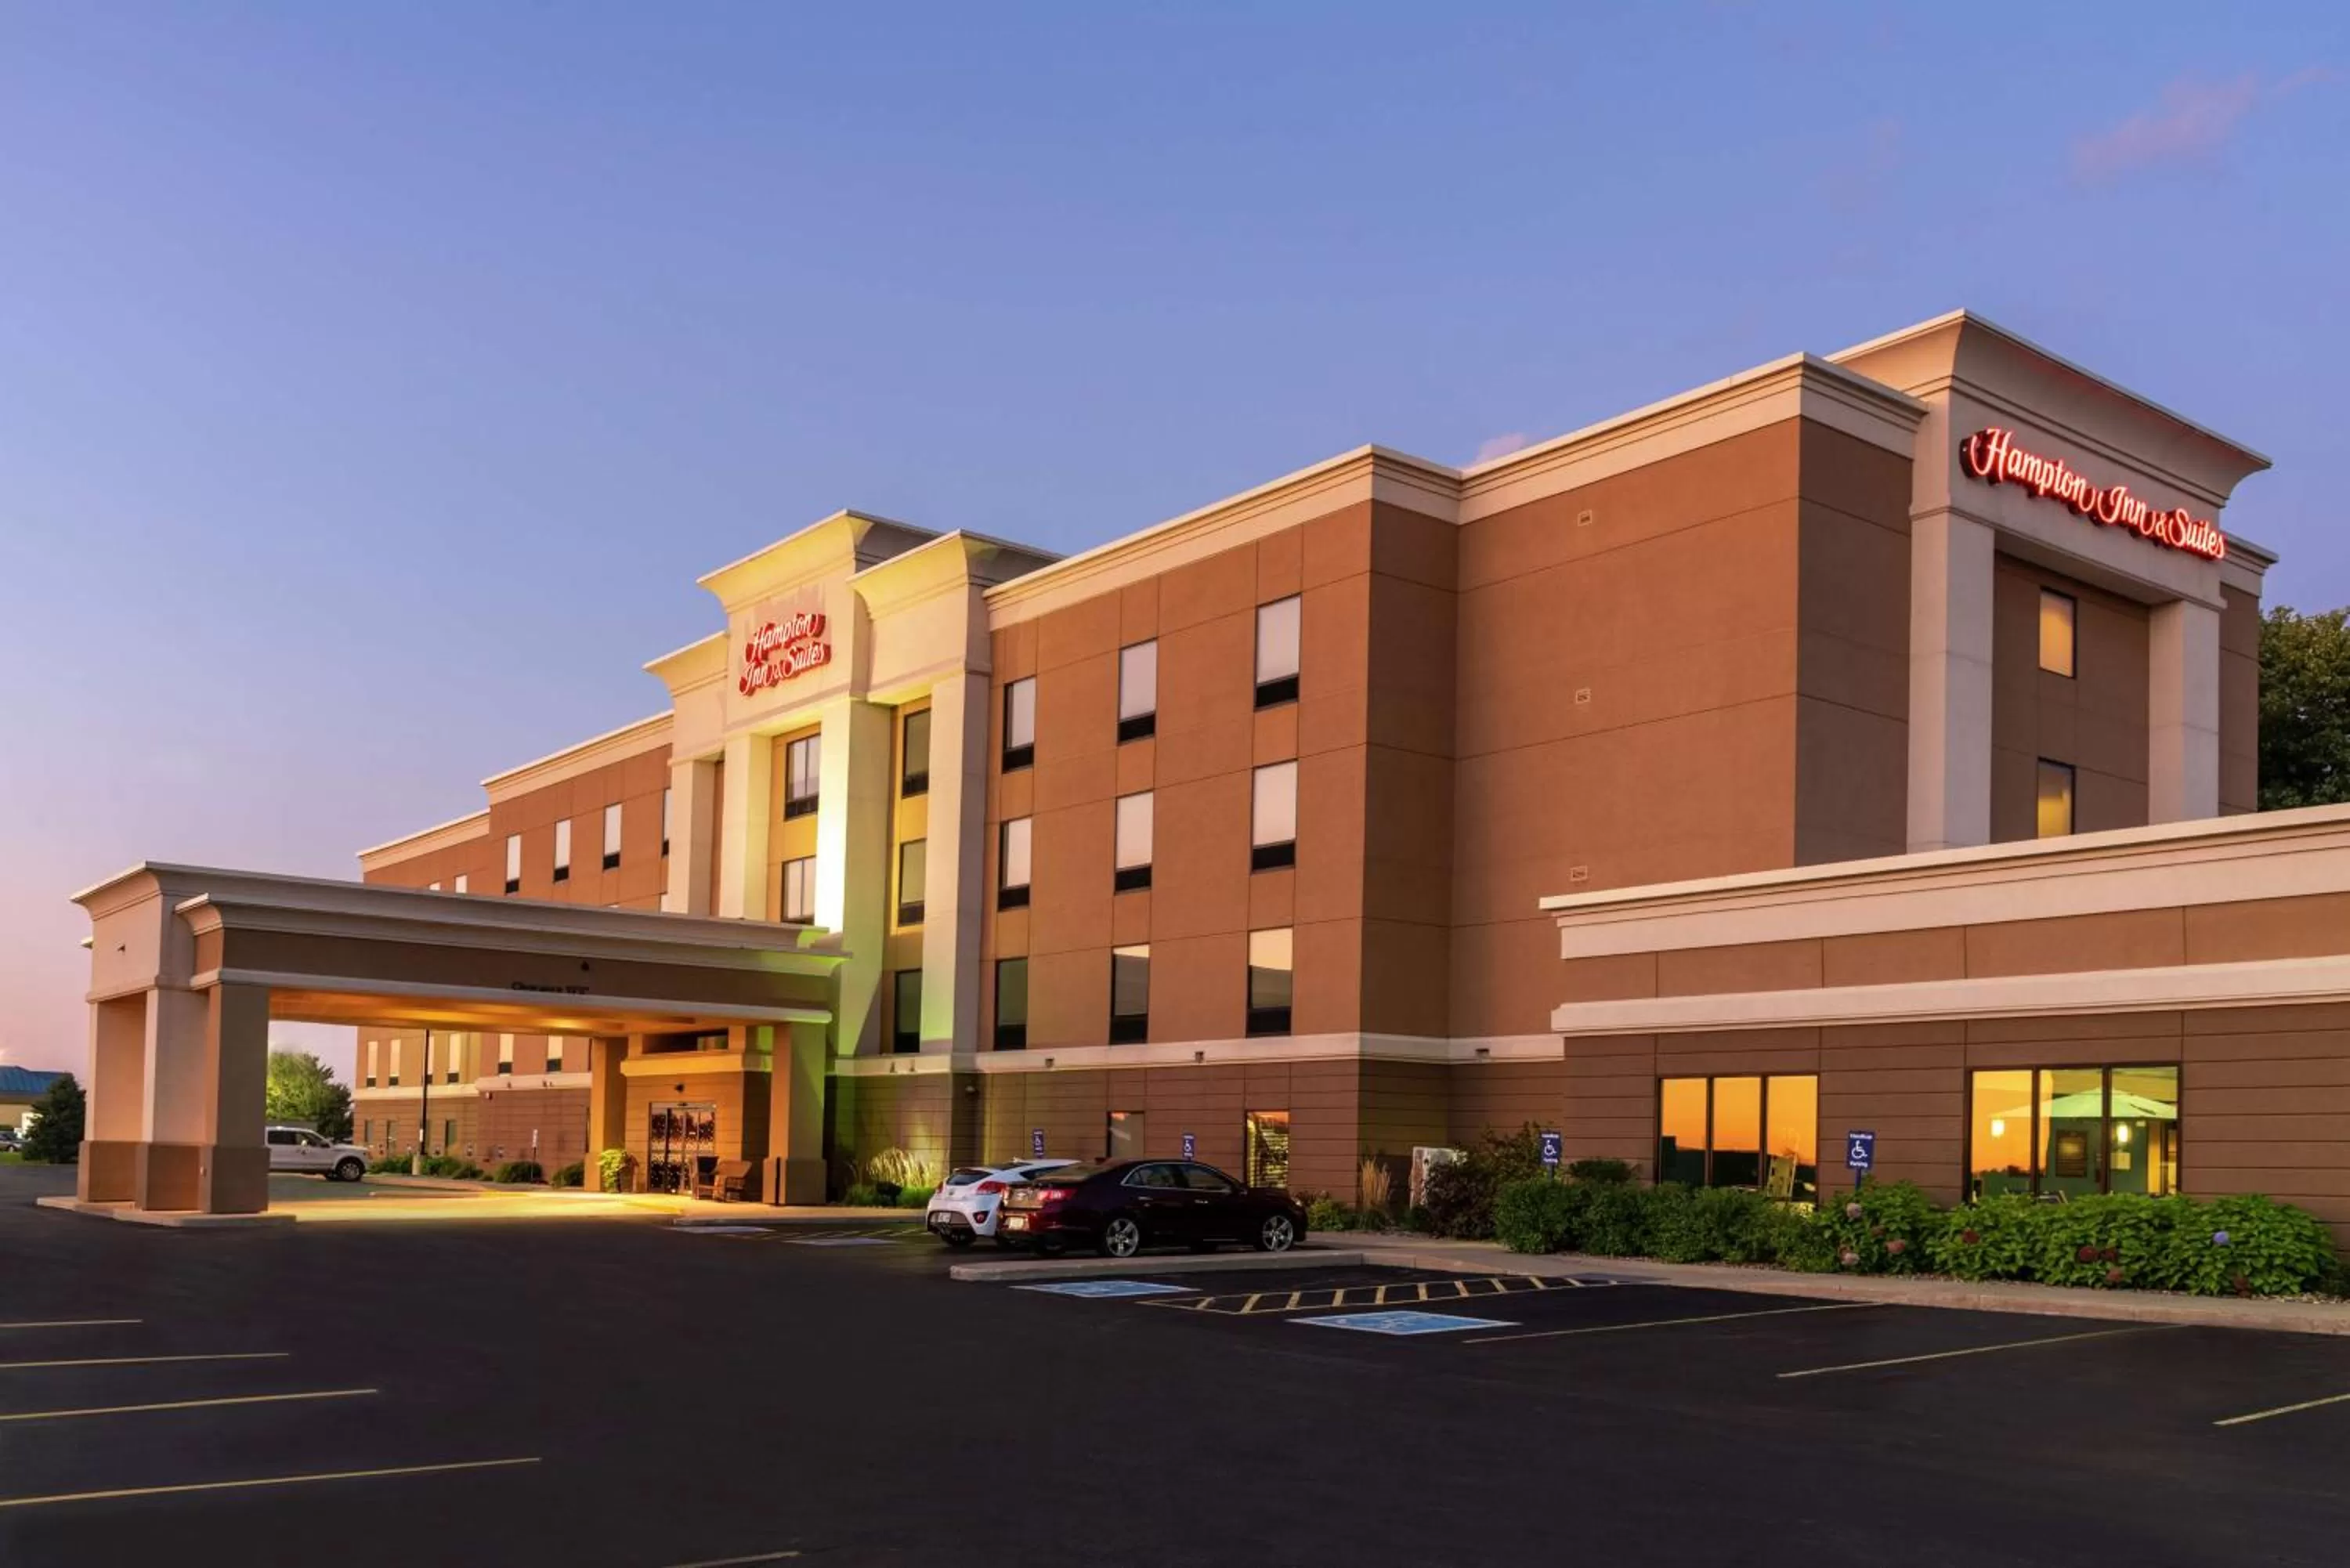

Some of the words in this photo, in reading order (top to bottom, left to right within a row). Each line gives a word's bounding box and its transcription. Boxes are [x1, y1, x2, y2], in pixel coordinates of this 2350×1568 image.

[1969, 428, 2096, 512] Hampton
[2098, 486, 2157, 535] Inn
[2168, 508, 2226, 559] Suites
[746, 613, 823, 663] Hampton
[740, 663, 775, 695] Inn
[782, 642, 828, 677] Suites
